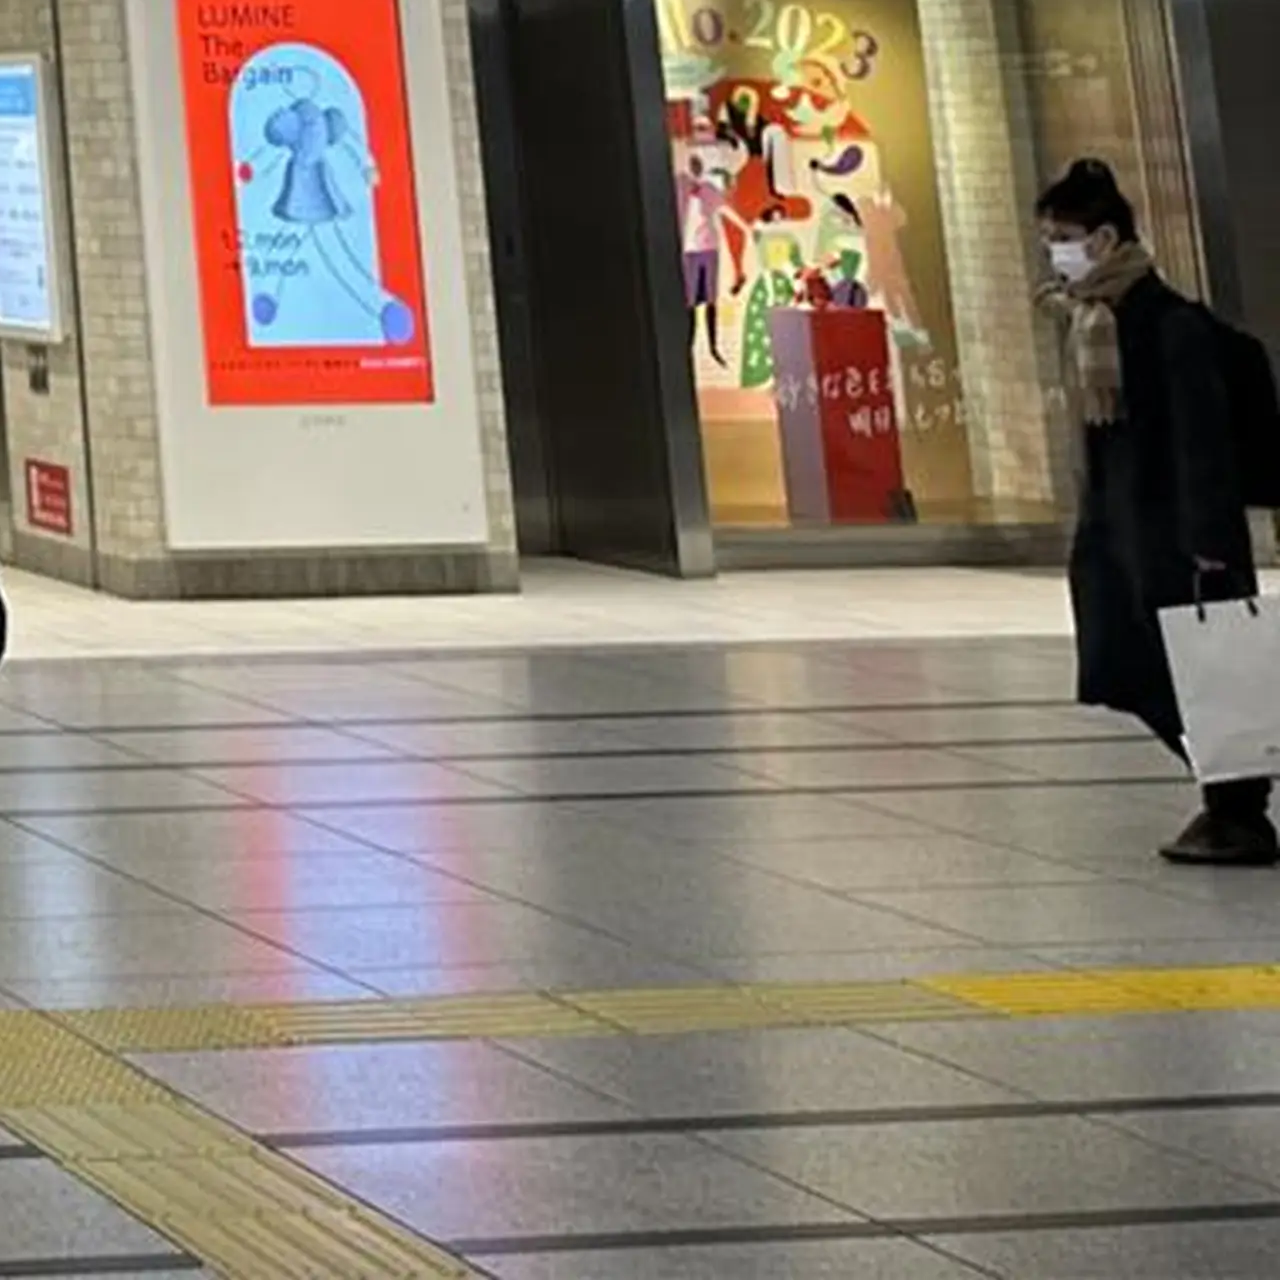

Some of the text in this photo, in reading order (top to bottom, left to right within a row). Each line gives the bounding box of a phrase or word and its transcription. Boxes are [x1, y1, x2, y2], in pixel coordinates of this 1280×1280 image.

[196, 3, 296, 30] LUMINE
[201, 33, 244, 59] The
[202, 61, 294, 91] Bargain
